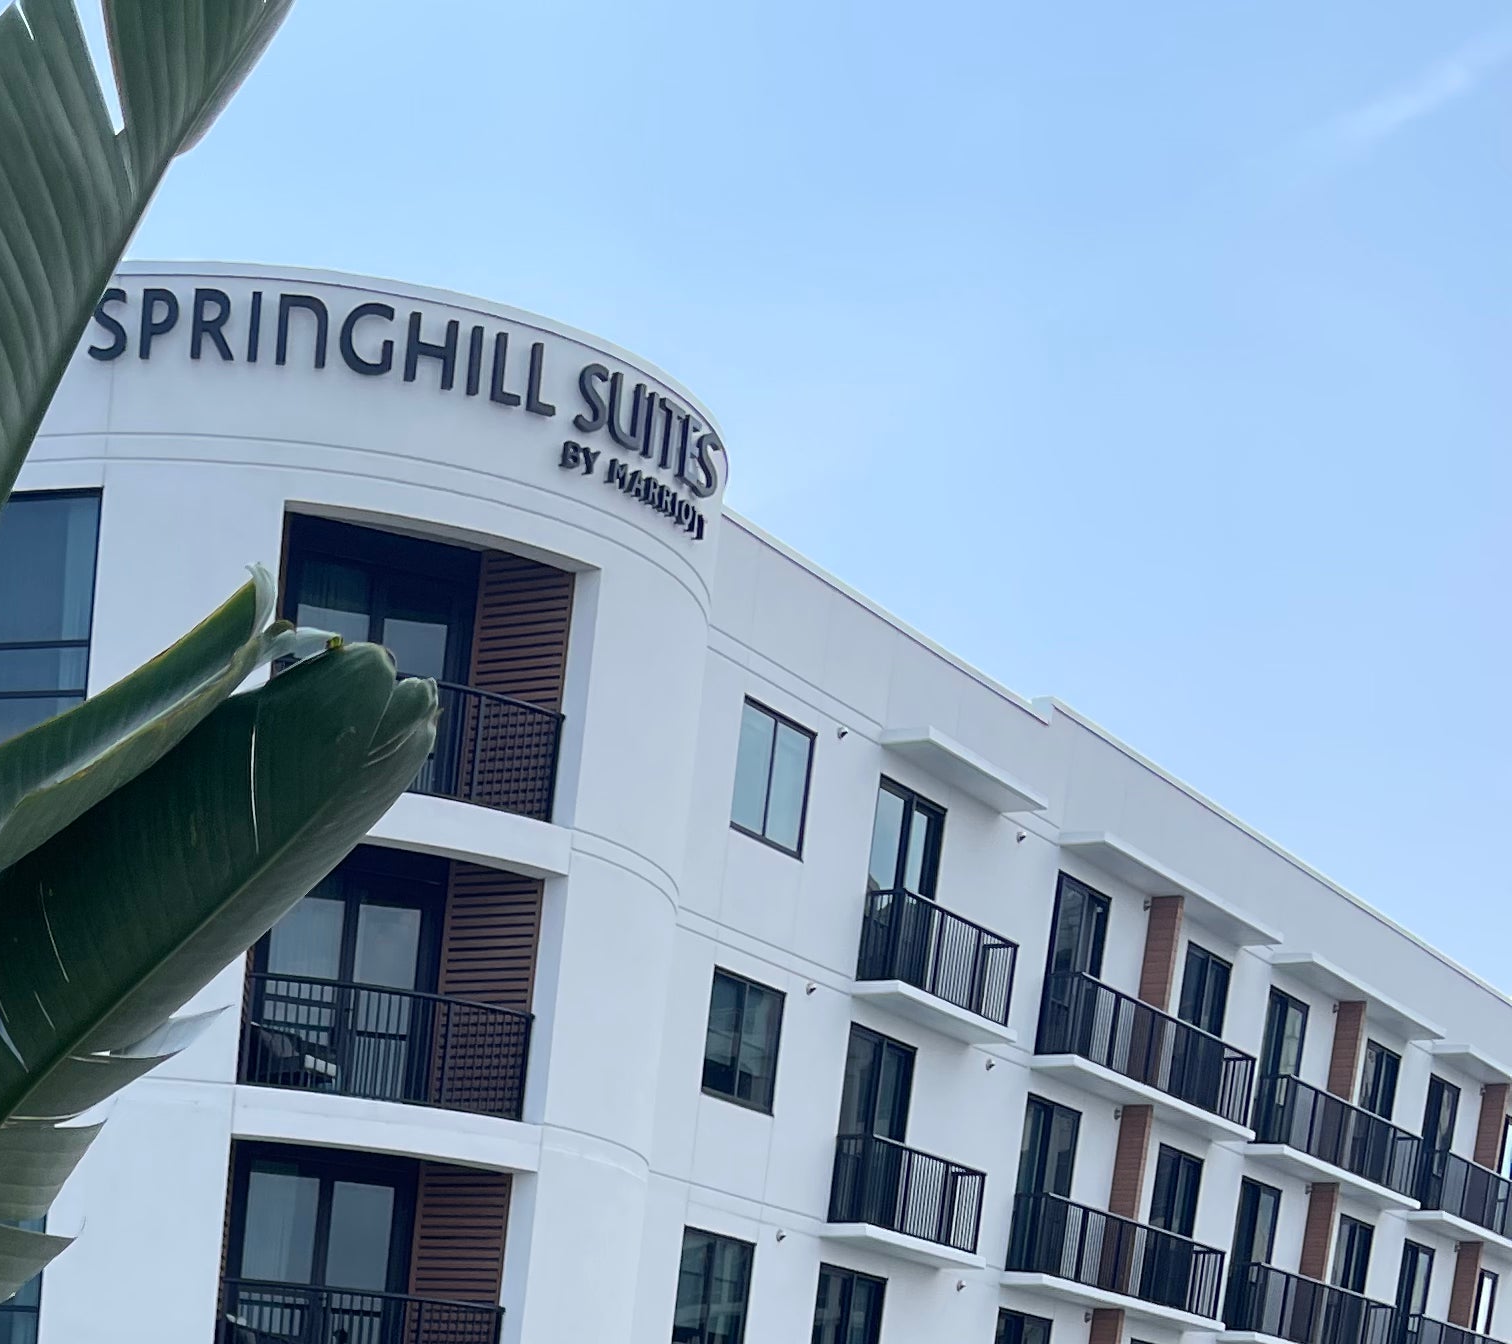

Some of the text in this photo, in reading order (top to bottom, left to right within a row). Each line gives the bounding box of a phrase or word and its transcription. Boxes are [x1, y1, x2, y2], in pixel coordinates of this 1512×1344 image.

[88, 288, 722, 498] SPRINGHILL SUITES
[559, 440, 601, 476] BY
